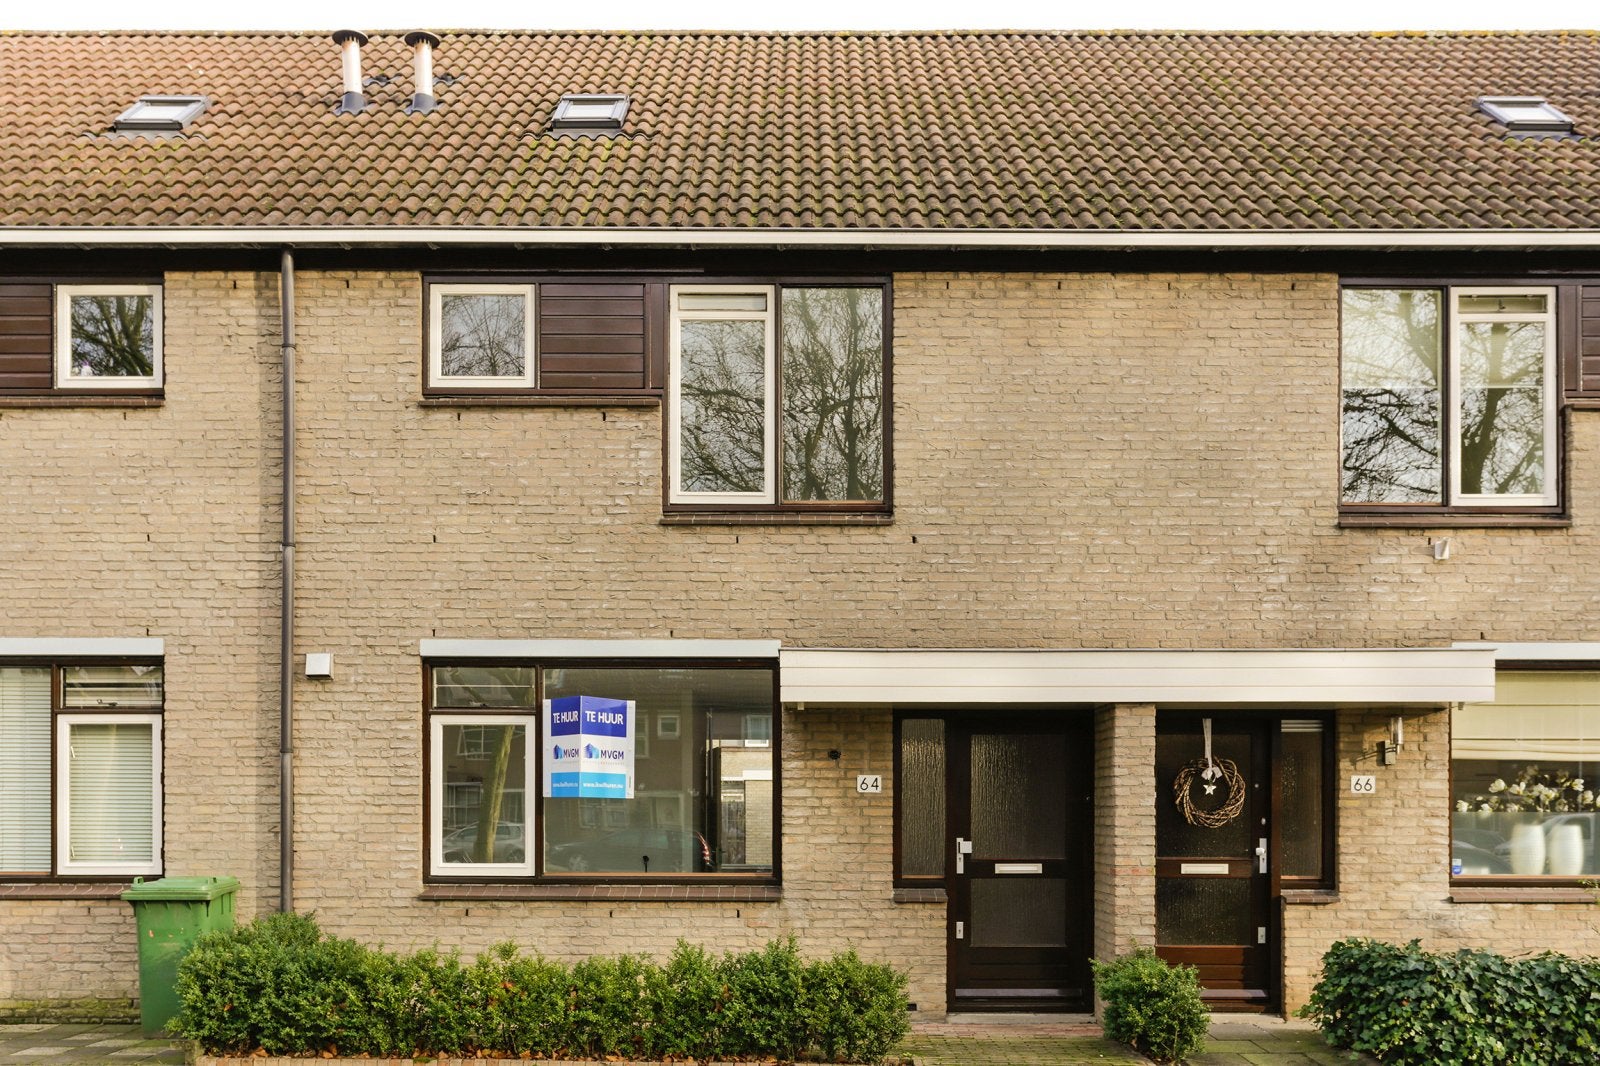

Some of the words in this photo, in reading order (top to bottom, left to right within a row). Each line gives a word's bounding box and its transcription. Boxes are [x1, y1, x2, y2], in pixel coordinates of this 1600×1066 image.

[553, 712, 560, 724] TE
[561, 710, 579, 723] HUUR
[585, 710, 596, 723] TE
[598, 712, 624, 725] HUUR
[563, 748, 579, 758] MVGM
[600, 750, 625, 760] MVGM
[860, 777, 879, 791] 64
[1354, 778, 1373, 792] 66
